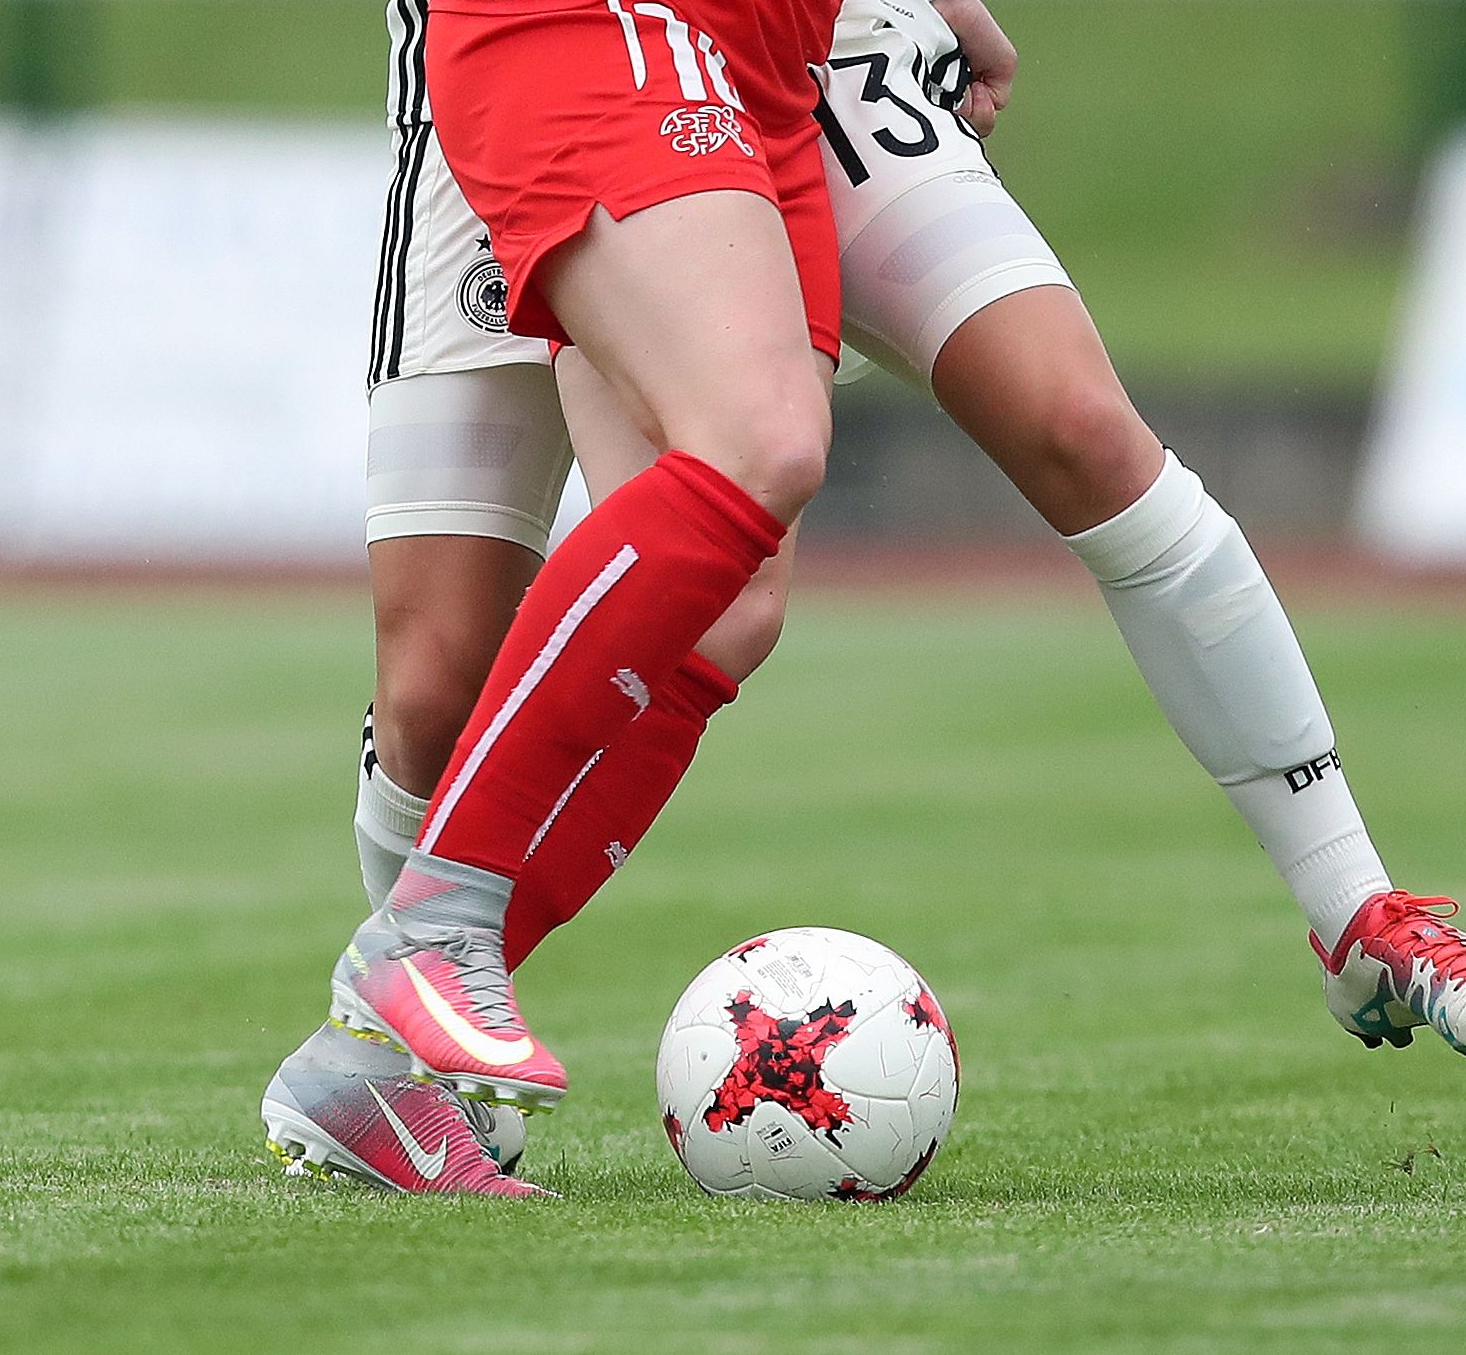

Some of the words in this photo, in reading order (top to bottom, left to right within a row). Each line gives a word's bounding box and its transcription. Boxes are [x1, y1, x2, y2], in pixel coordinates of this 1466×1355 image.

[808, 52, 939, 188] 13
[1284, 747, 1341, 794] DFB
[770, 1137, 793, 1152] FIFA
